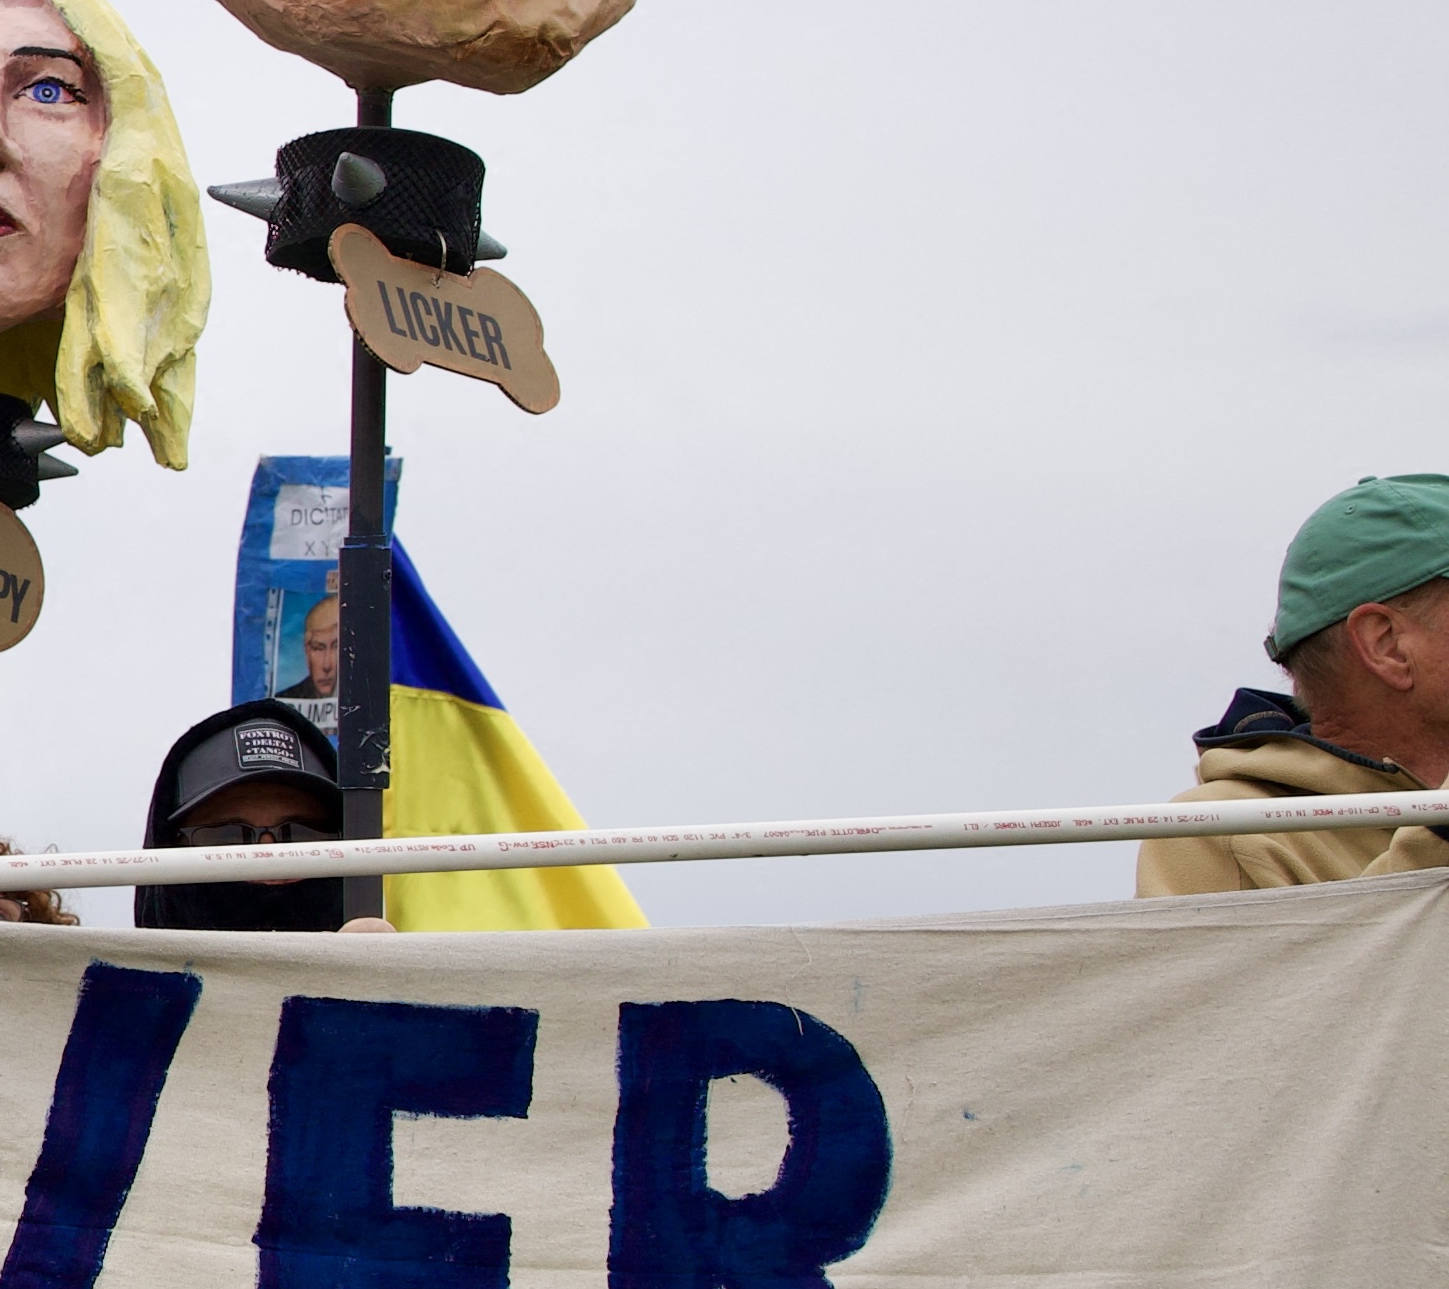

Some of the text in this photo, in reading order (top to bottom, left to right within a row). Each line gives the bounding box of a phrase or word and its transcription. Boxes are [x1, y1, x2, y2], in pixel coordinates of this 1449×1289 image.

[375, 280, 512, 371] LICKER
[239, 730, 295, 743] FOXTROT
[252, 739, 287, 749] DELTA
[252, 747, 289, 758] TANGO
